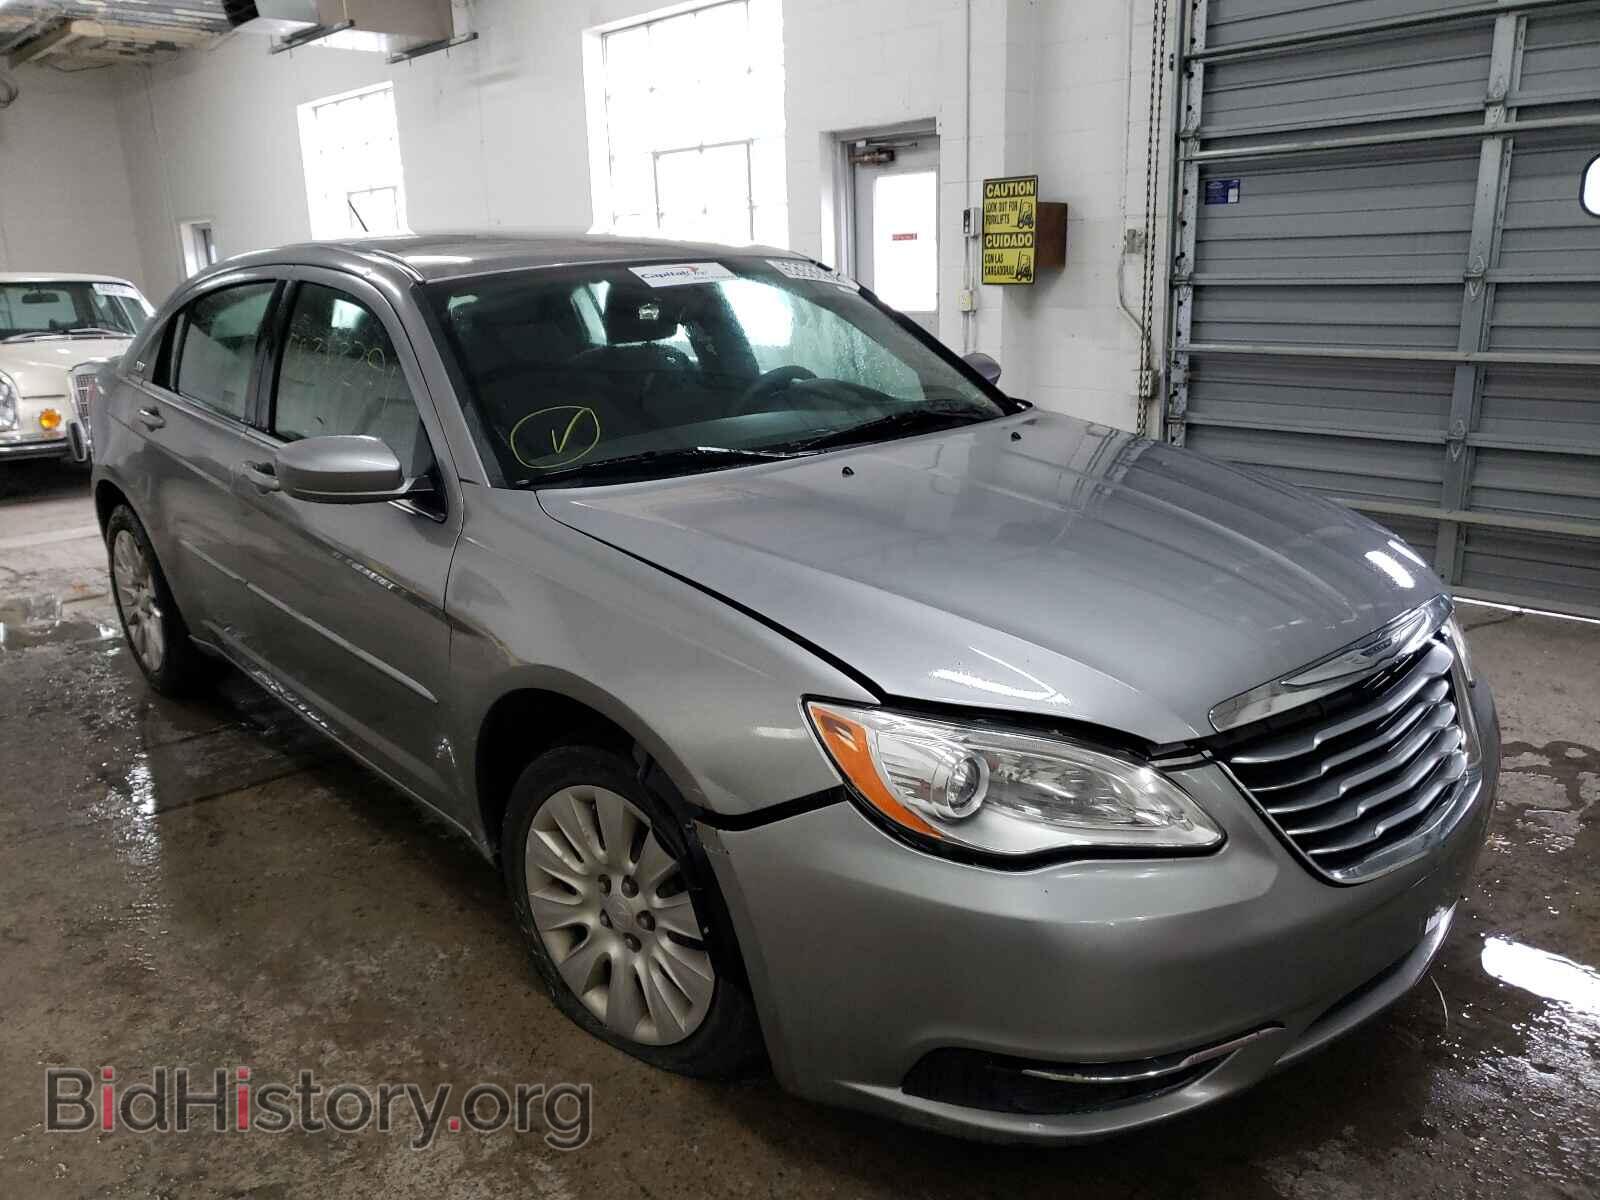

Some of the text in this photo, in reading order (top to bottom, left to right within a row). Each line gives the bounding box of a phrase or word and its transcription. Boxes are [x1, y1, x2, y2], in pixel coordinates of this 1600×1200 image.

[986, 181, 1034, 198] CAUTION
[999, 201, 1008, 212] OUT
[1009, 200, 1018, 212] FOR
[986, 214, 1010, 225] FORKLIFTS
[985, 233, 1033, 248] CUIDADO
[985, 253, 994, 264] CON
